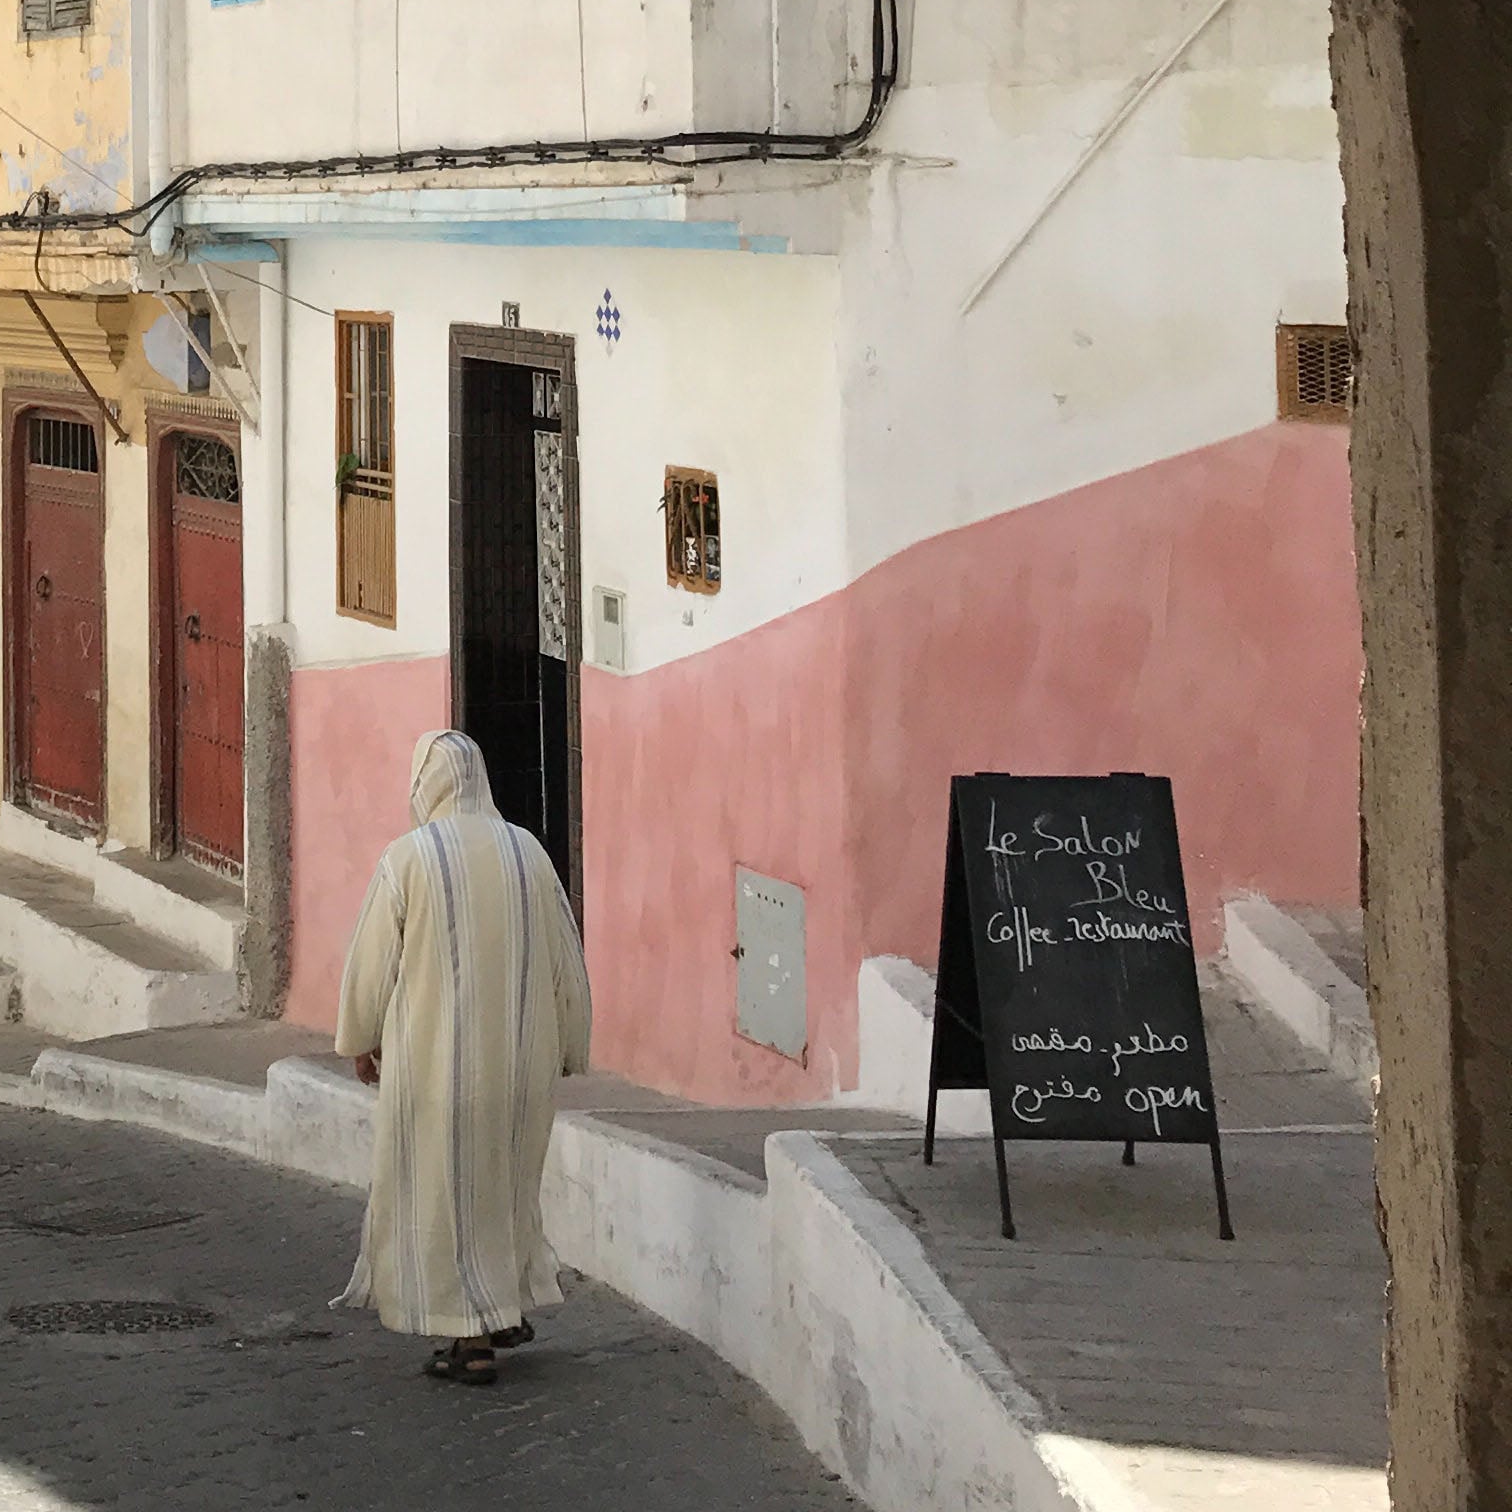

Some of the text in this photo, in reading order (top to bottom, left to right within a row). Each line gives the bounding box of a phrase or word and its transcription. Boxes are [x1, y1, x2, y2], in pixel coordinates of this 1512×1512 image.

[985, 797, 1025, 855] Le
[1069, 861, 1176, 913] Bleu
[1111, 1022, 1188, 1076] مطعم
[1011, 1074, 1102, 1122] مفتوح
[1125, 1086, 1208, 1136] open
